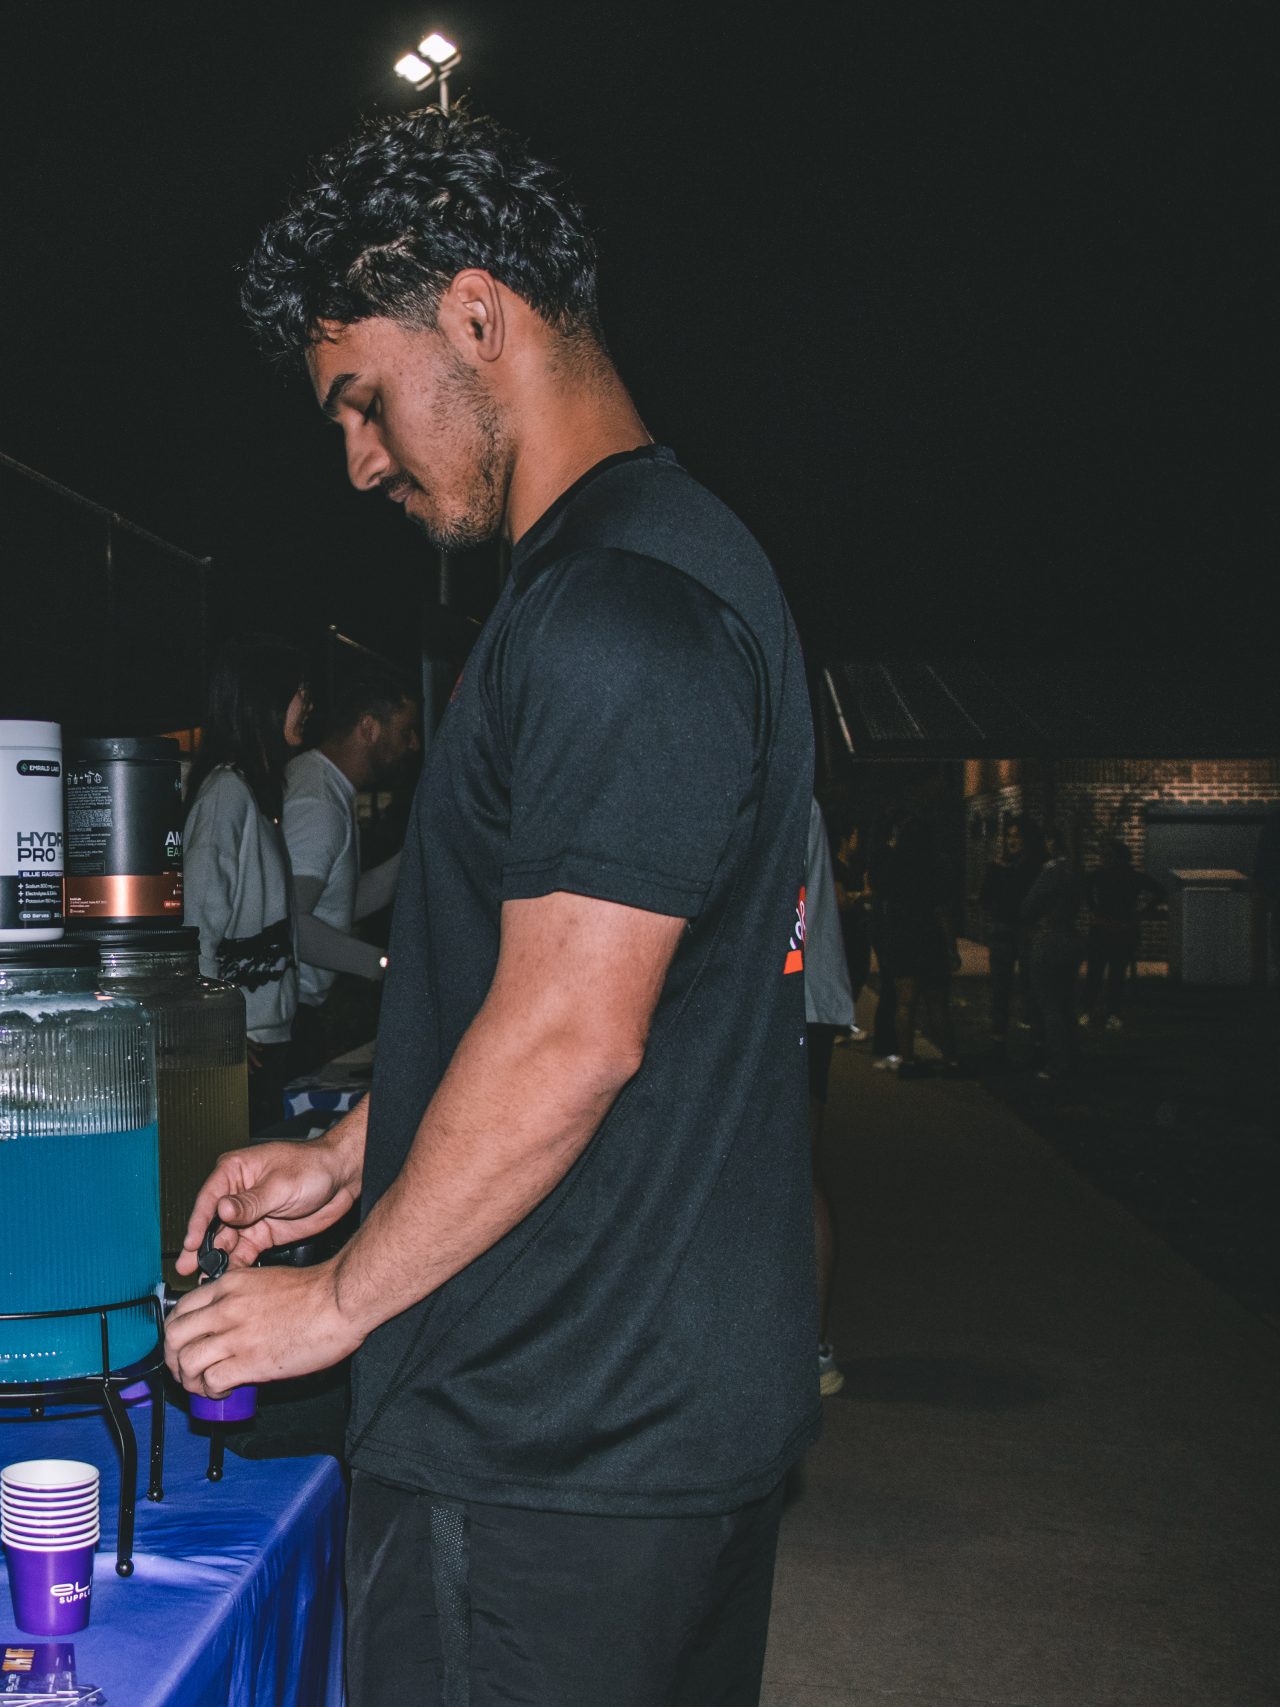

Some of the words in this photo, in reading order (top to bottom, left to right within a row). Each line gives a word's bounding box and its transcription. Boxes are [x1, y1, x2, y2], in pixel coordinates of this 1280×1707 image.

[17, 831, 63, 847] HYDR
[165, 831, 182, 846] AM
[17, 848, 55, 862] PRO
